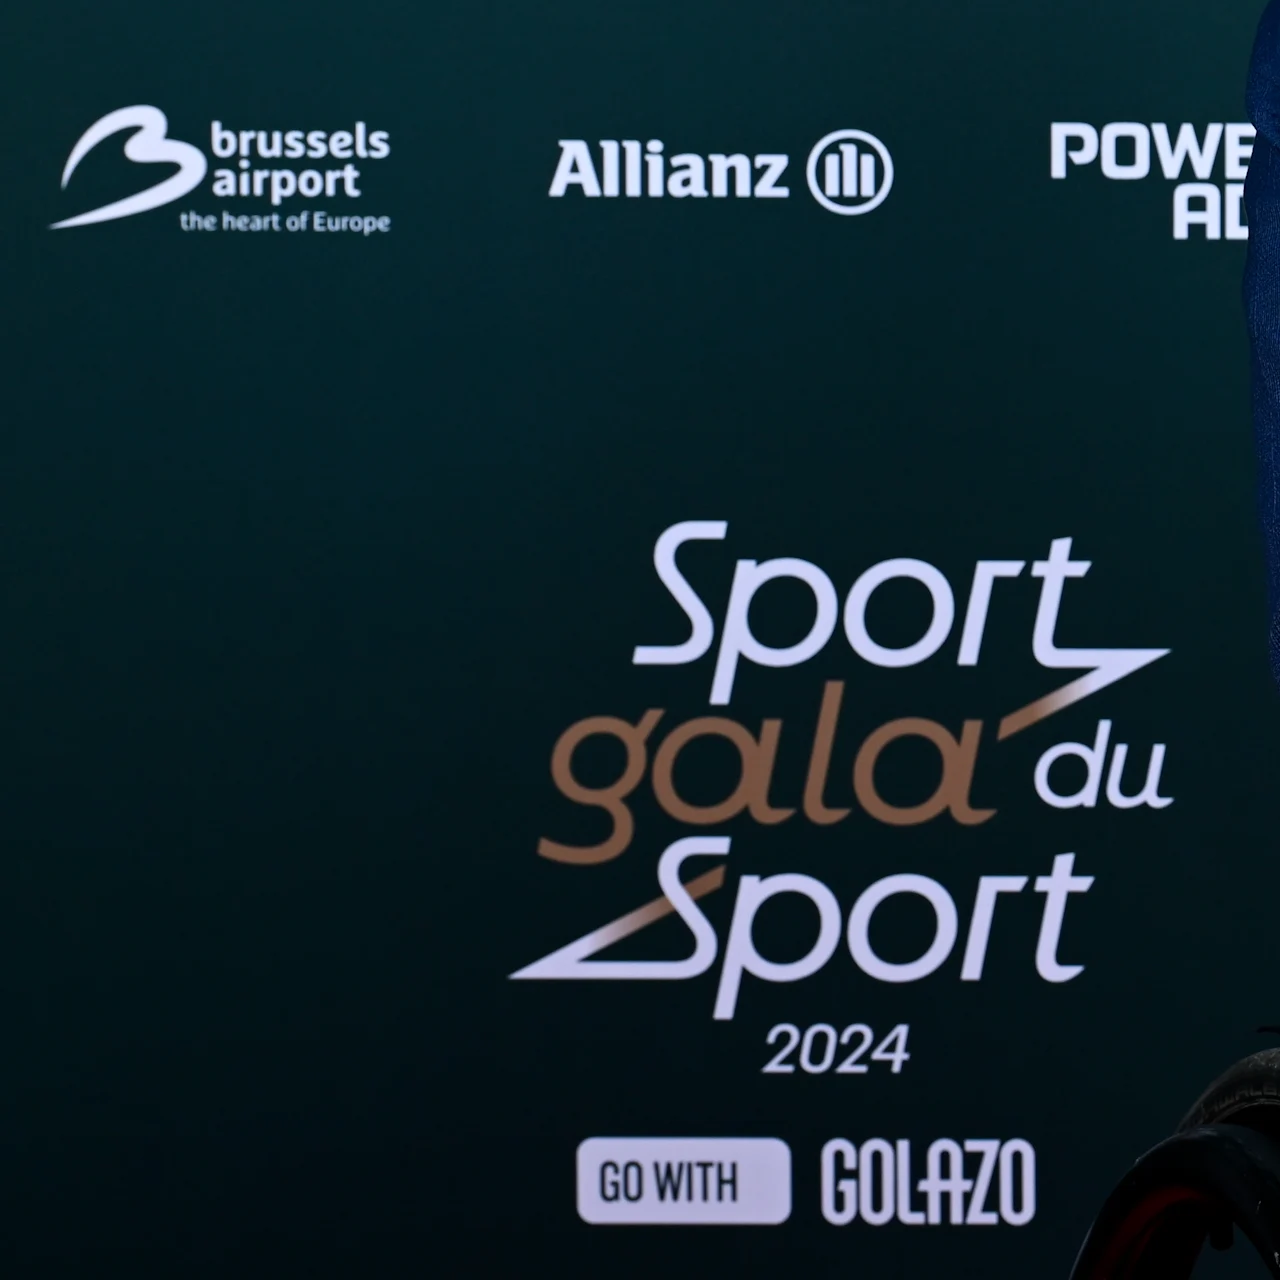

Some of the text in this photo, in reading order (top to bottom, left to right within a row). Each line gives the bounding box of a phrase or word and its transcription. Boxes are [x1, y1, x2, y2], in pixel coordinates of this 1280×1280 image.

[211, 121, 390, 158] brussels
[1050, 122, 1257, 179] POWE
[212, 160, 360, 205] airport
[549, 140, 789, 197] Allianz
[180, 211, 390, 236] the heart of Europe
[632, 520, 1172, 705] Sport
[539, 683, 1173, 863] gala du
[507, 836, 1095, 1020] Sport
[762, 1024, 910, 1073] 2024
[600, 1138, 1035, 1226] GO WITH GOLAZO
